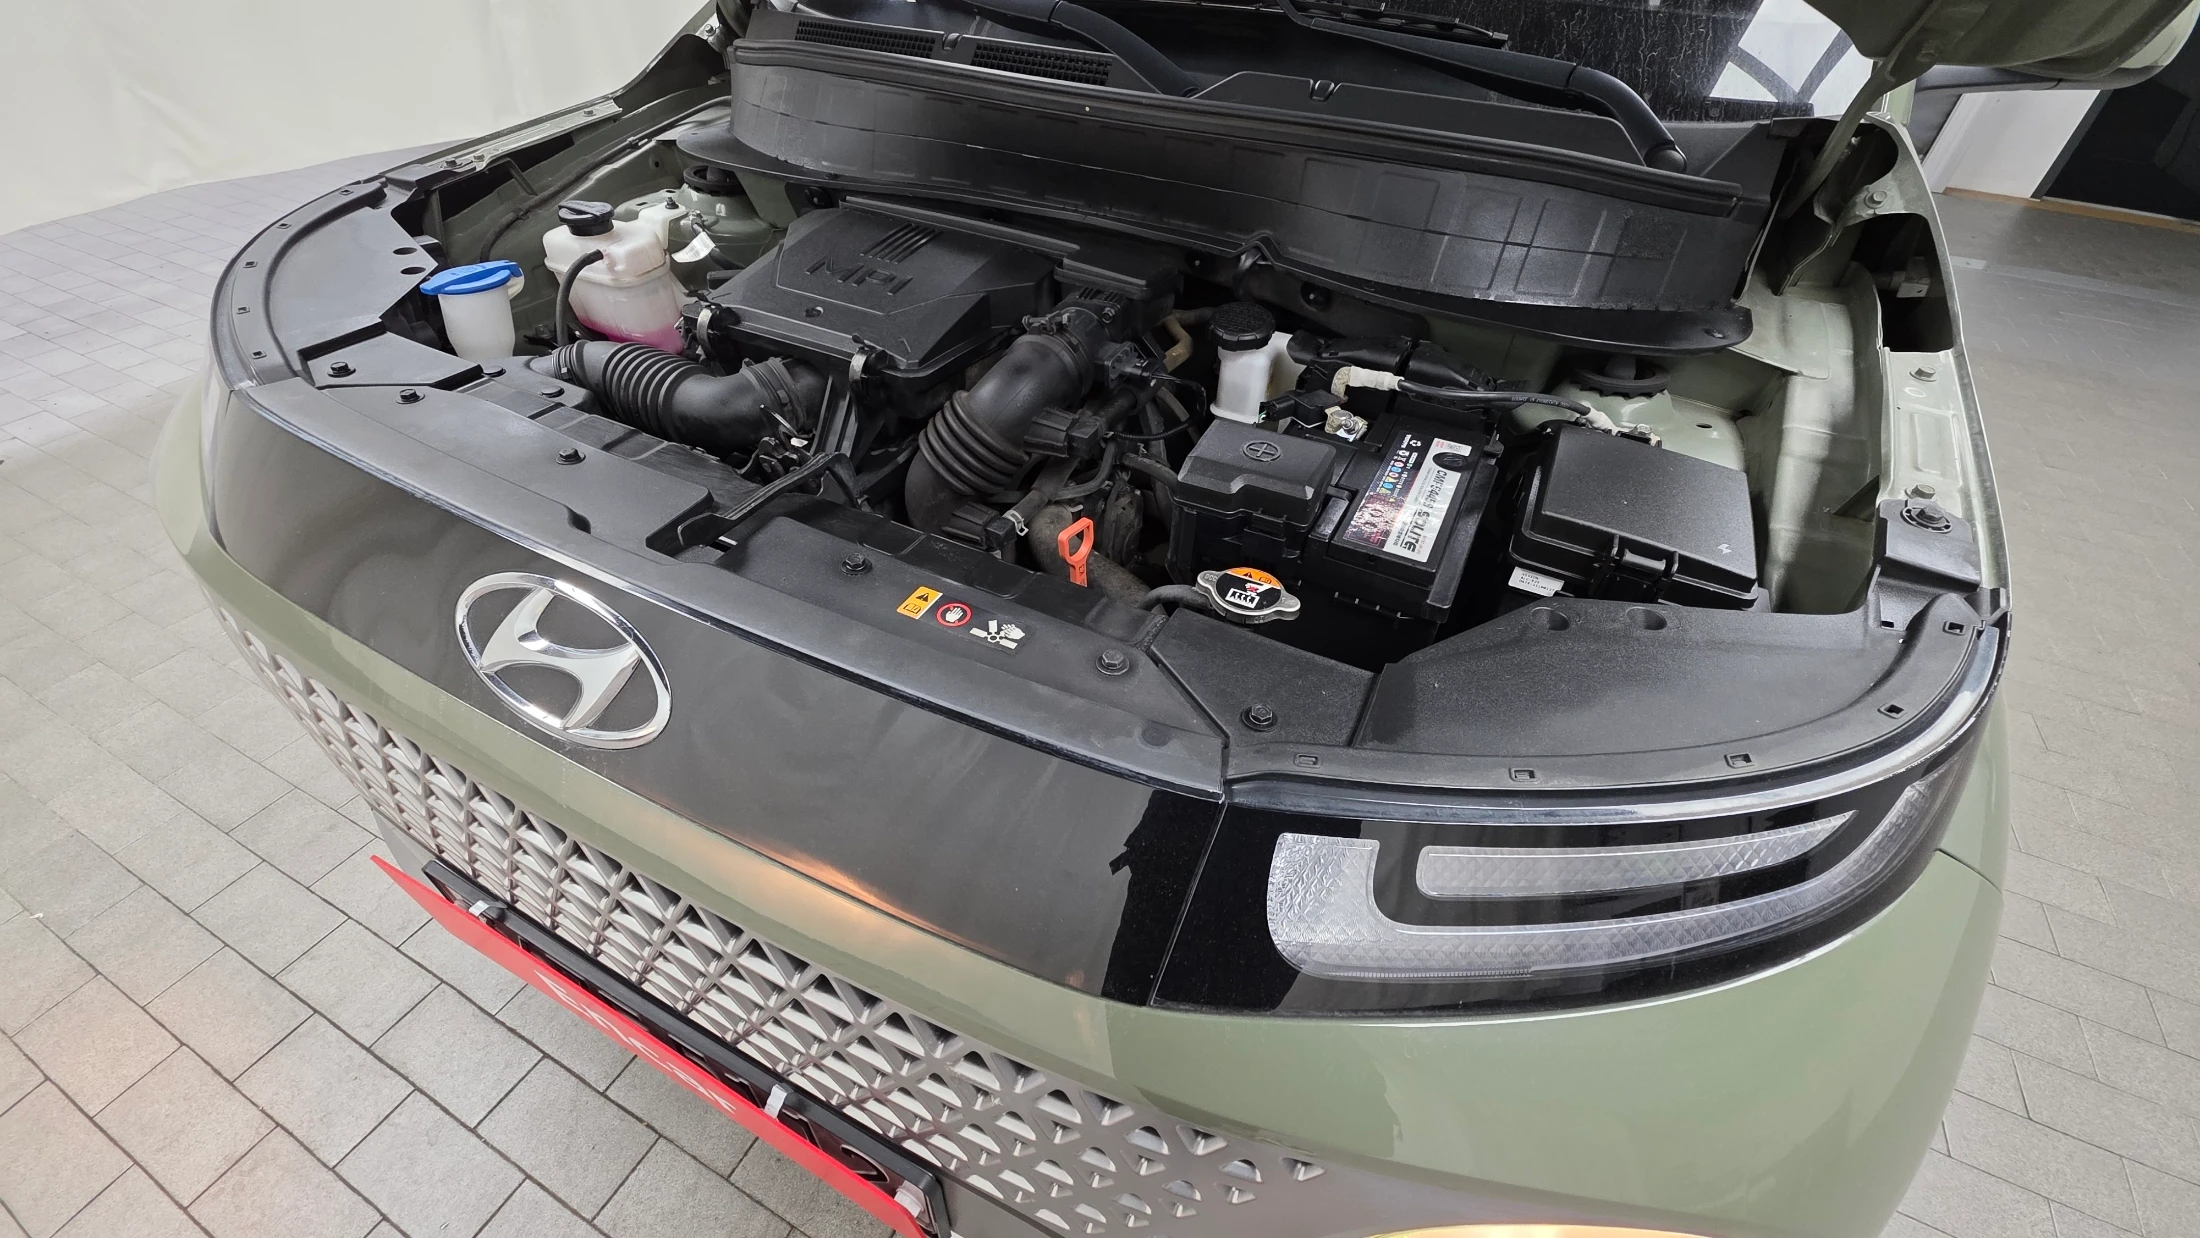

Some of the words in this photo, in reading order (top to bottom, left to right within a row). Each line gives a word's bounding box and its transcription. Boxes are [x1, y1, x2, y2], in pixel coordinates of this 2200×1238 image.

[804, 256, 914, 296] MPI
[1402, 510, 1430, 553] SOLITE
[534, 969, 737, 1115] Encar
